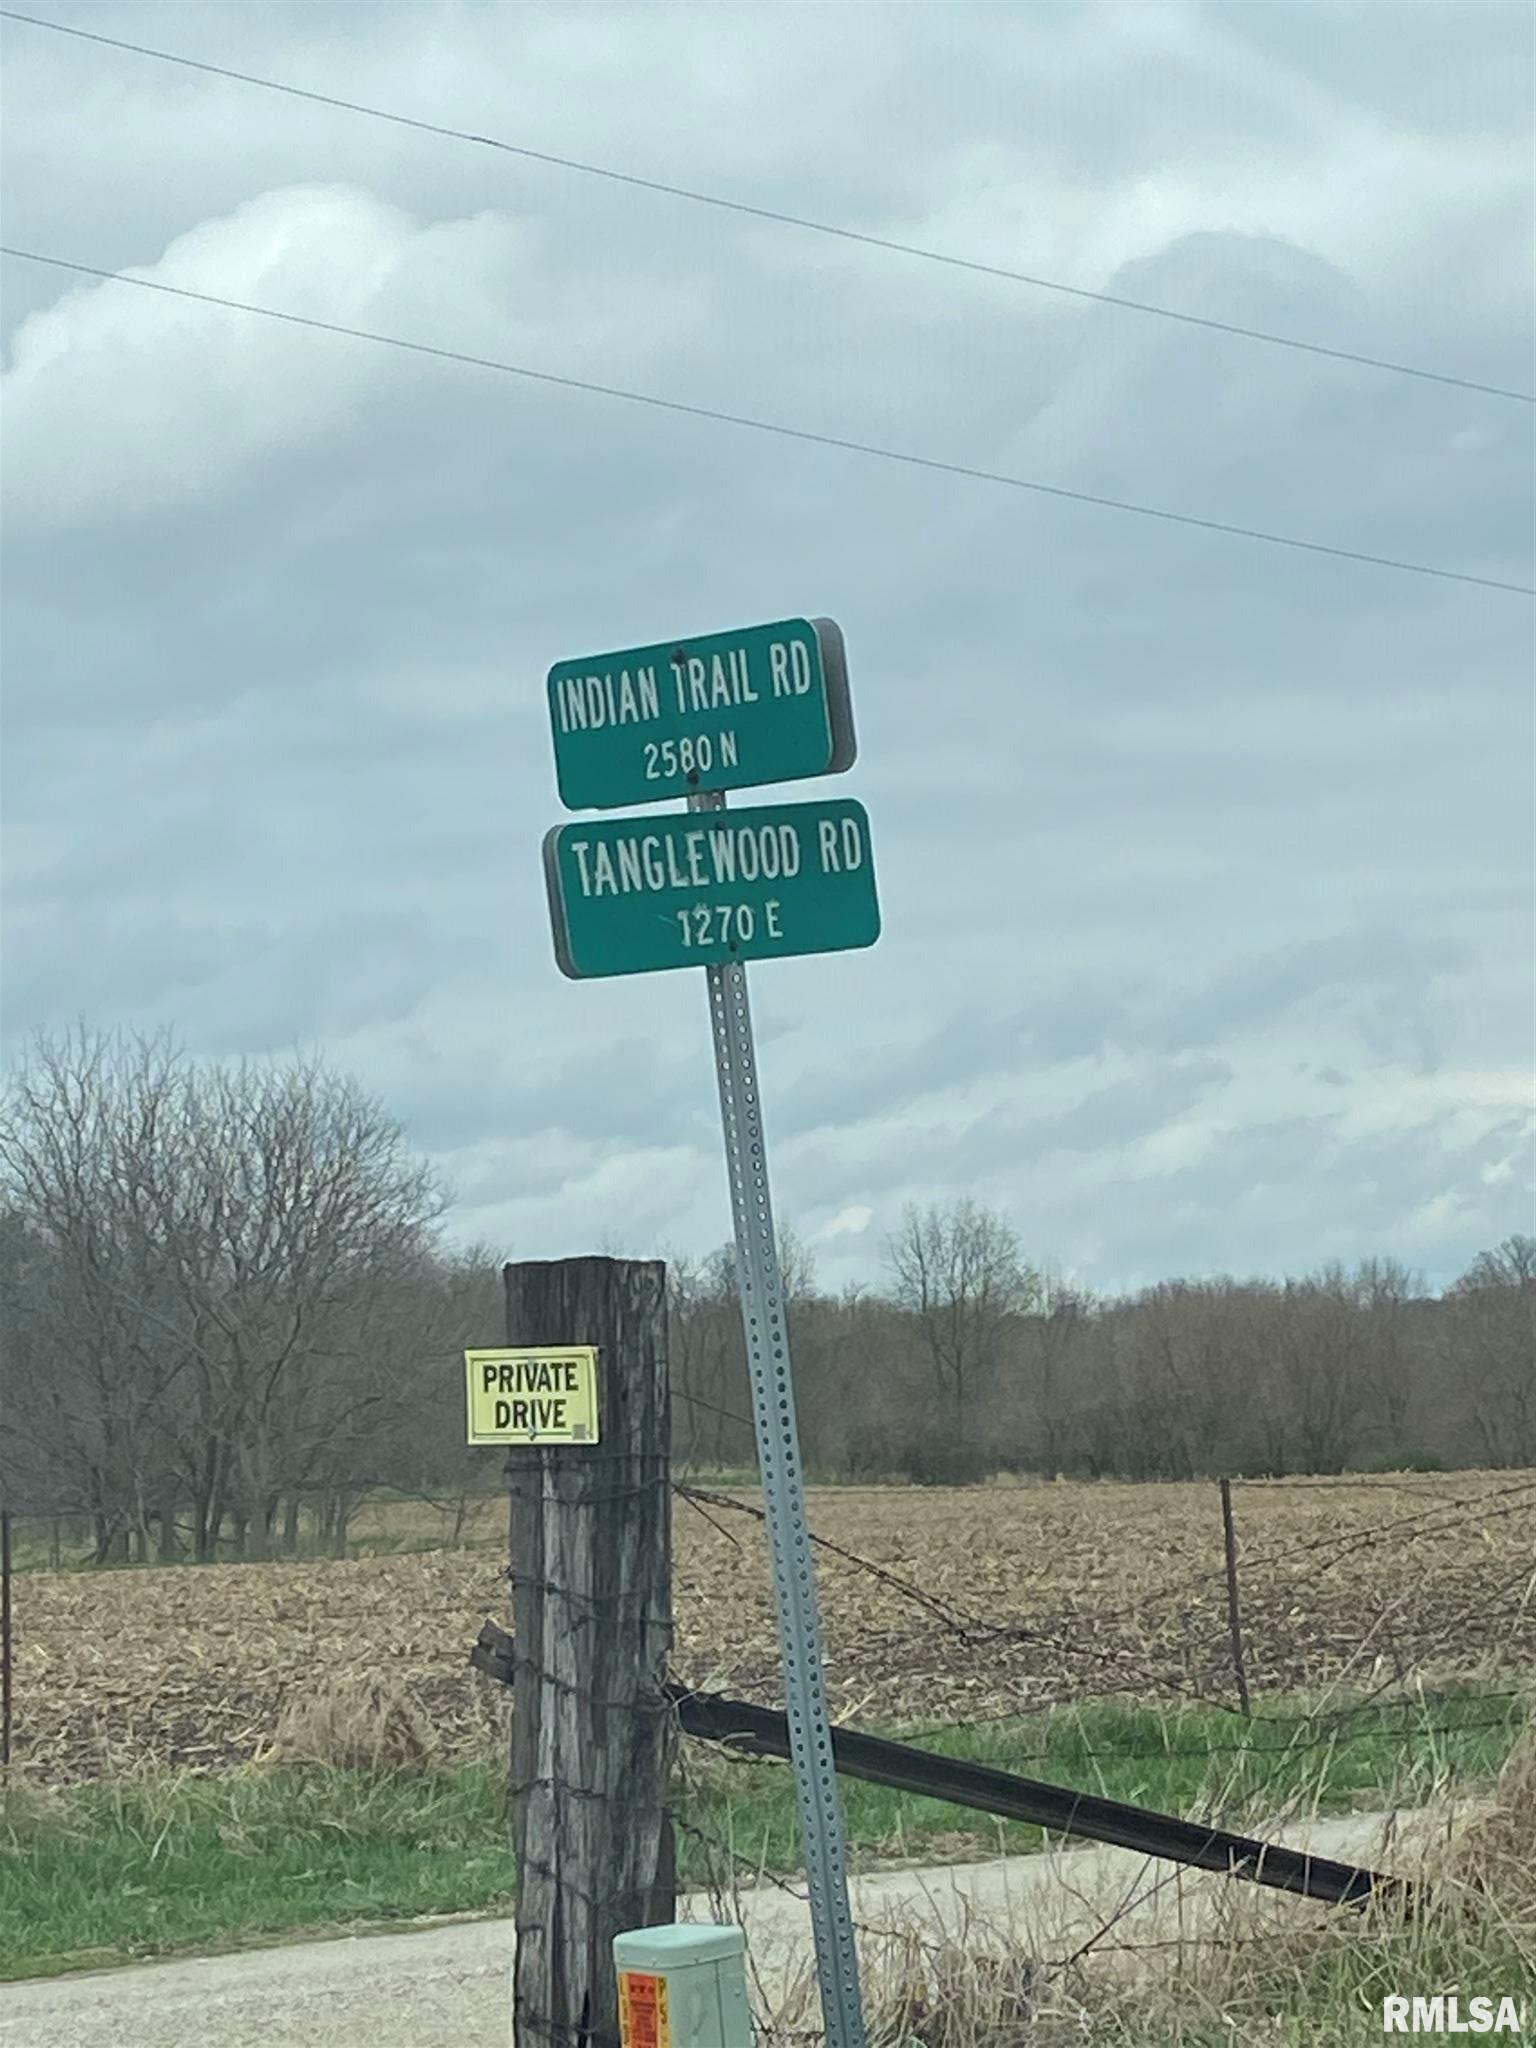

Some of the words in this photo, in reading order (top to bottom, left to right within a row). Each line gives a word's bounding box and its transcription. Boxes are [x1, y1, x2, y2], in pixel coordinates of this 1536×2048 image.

[557, 666, 660, 733] INDIAN
[670, 649, 759, 714] TRAIL
[770, 640, 812, 698] RD
[644, 734, 713, 779] 2580
[720, 731, 738, 768] N
[571, 824, 800, 897] TANGLEWOOD
[818, 818, 862, 873] RD
[677, 903, 753, 947] 1270
[765, 901, 783, 938] E
[483, 1362, 579, 1393] PRIVATE
[495, 1399, 567, 1429] DRIVE
